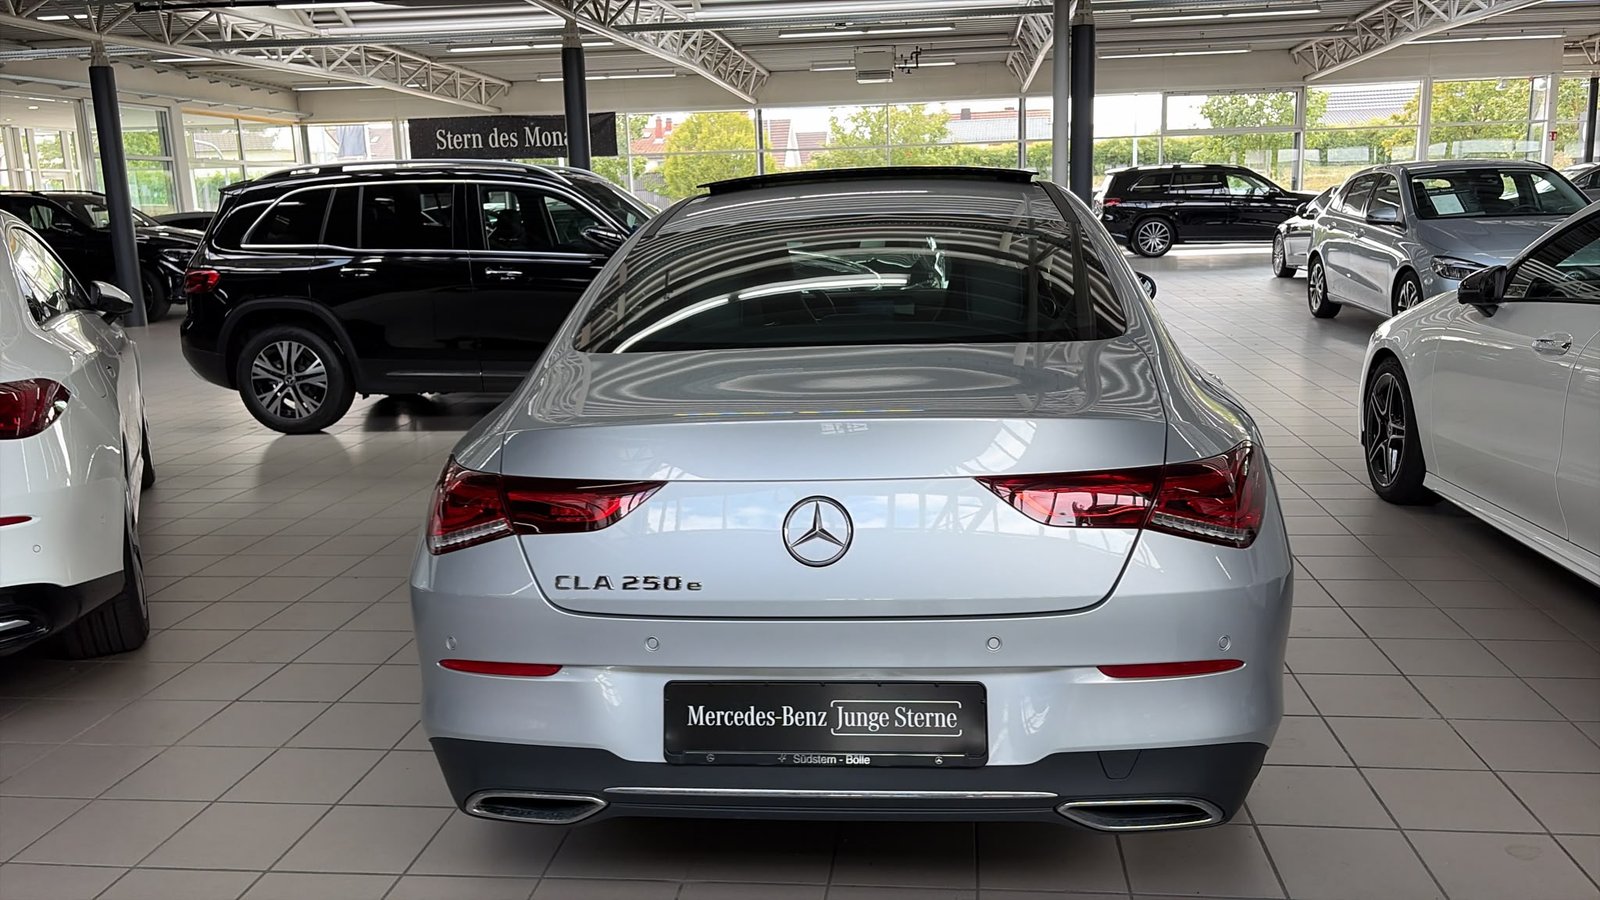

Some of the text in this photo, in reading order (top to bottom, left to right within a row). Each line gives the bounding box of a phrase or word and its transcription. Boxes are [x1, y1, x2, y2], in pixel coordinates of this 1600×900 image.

[436, 129, 483, 150] Stern
[488, 128, 519, 148] des
[554, 575, 614, 590] CLA
[687, 705, 958, 732] Mercedes-Benz Junge Sterne
[793, 753, 837, 764] Südstern
